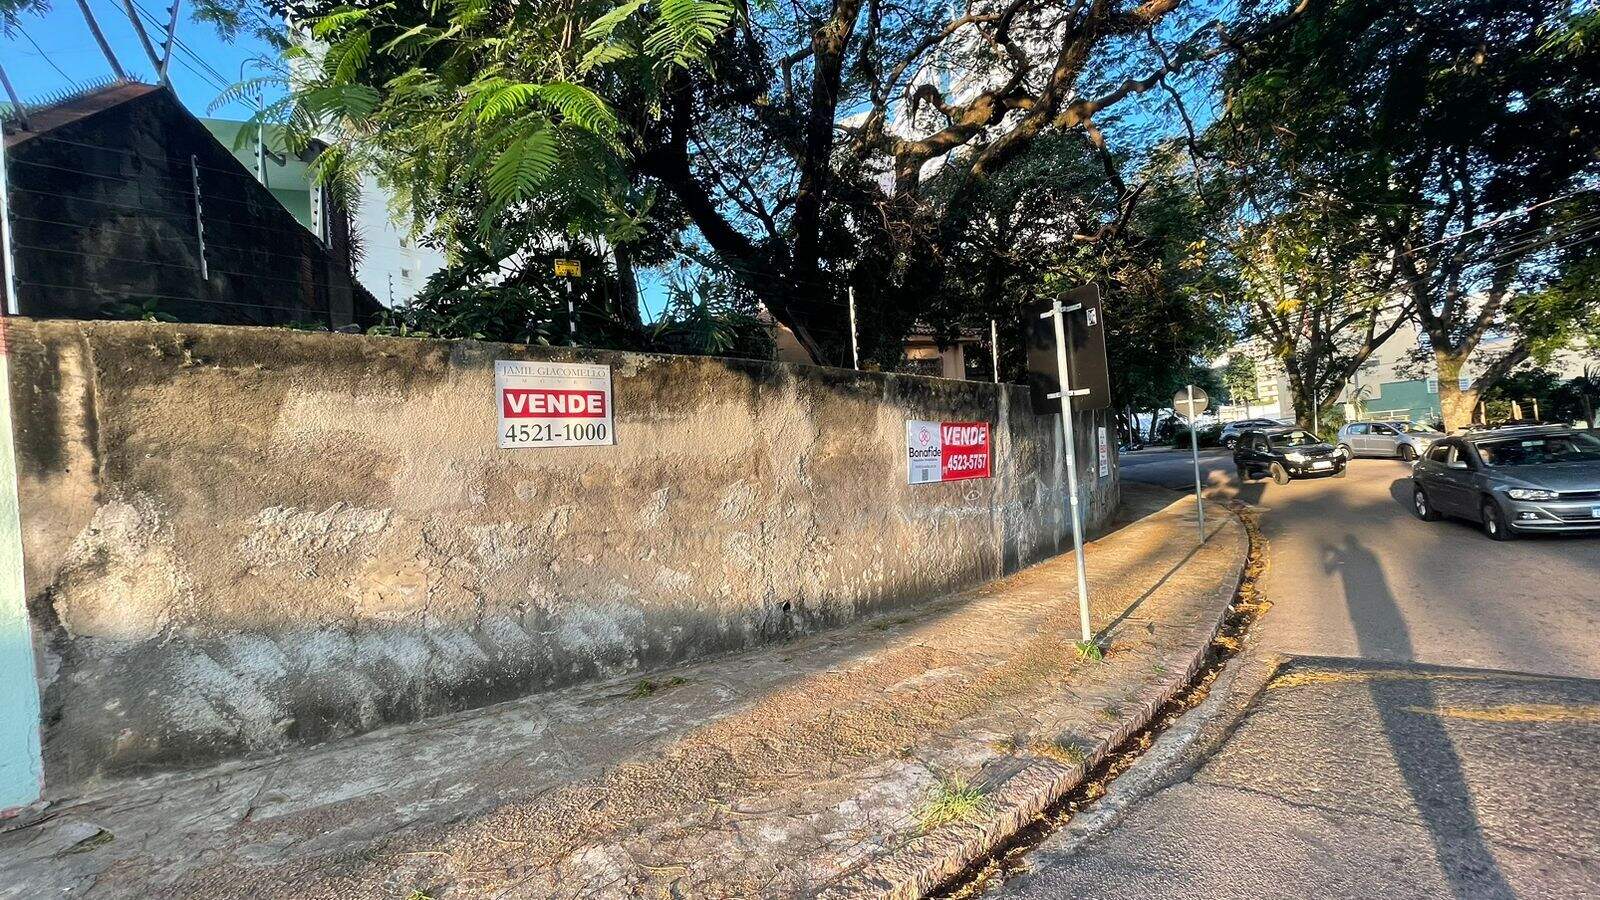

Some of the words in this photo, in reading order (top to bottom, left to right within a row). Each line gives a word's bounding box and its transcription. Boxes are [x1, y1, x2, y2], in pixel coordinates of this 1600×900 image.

[503, 366, 535, 376] JAMIL
[537, 367, 605, 377] GIACOMELLO
[506, 394, 602, 413] VENDE
[505, 423, 606, 442] 4521-1000
[943, 427, 986, 445] VENDE
[909, 446, 941, 457] Bonafide
[948, 454, 986, 470] 4523-5757
